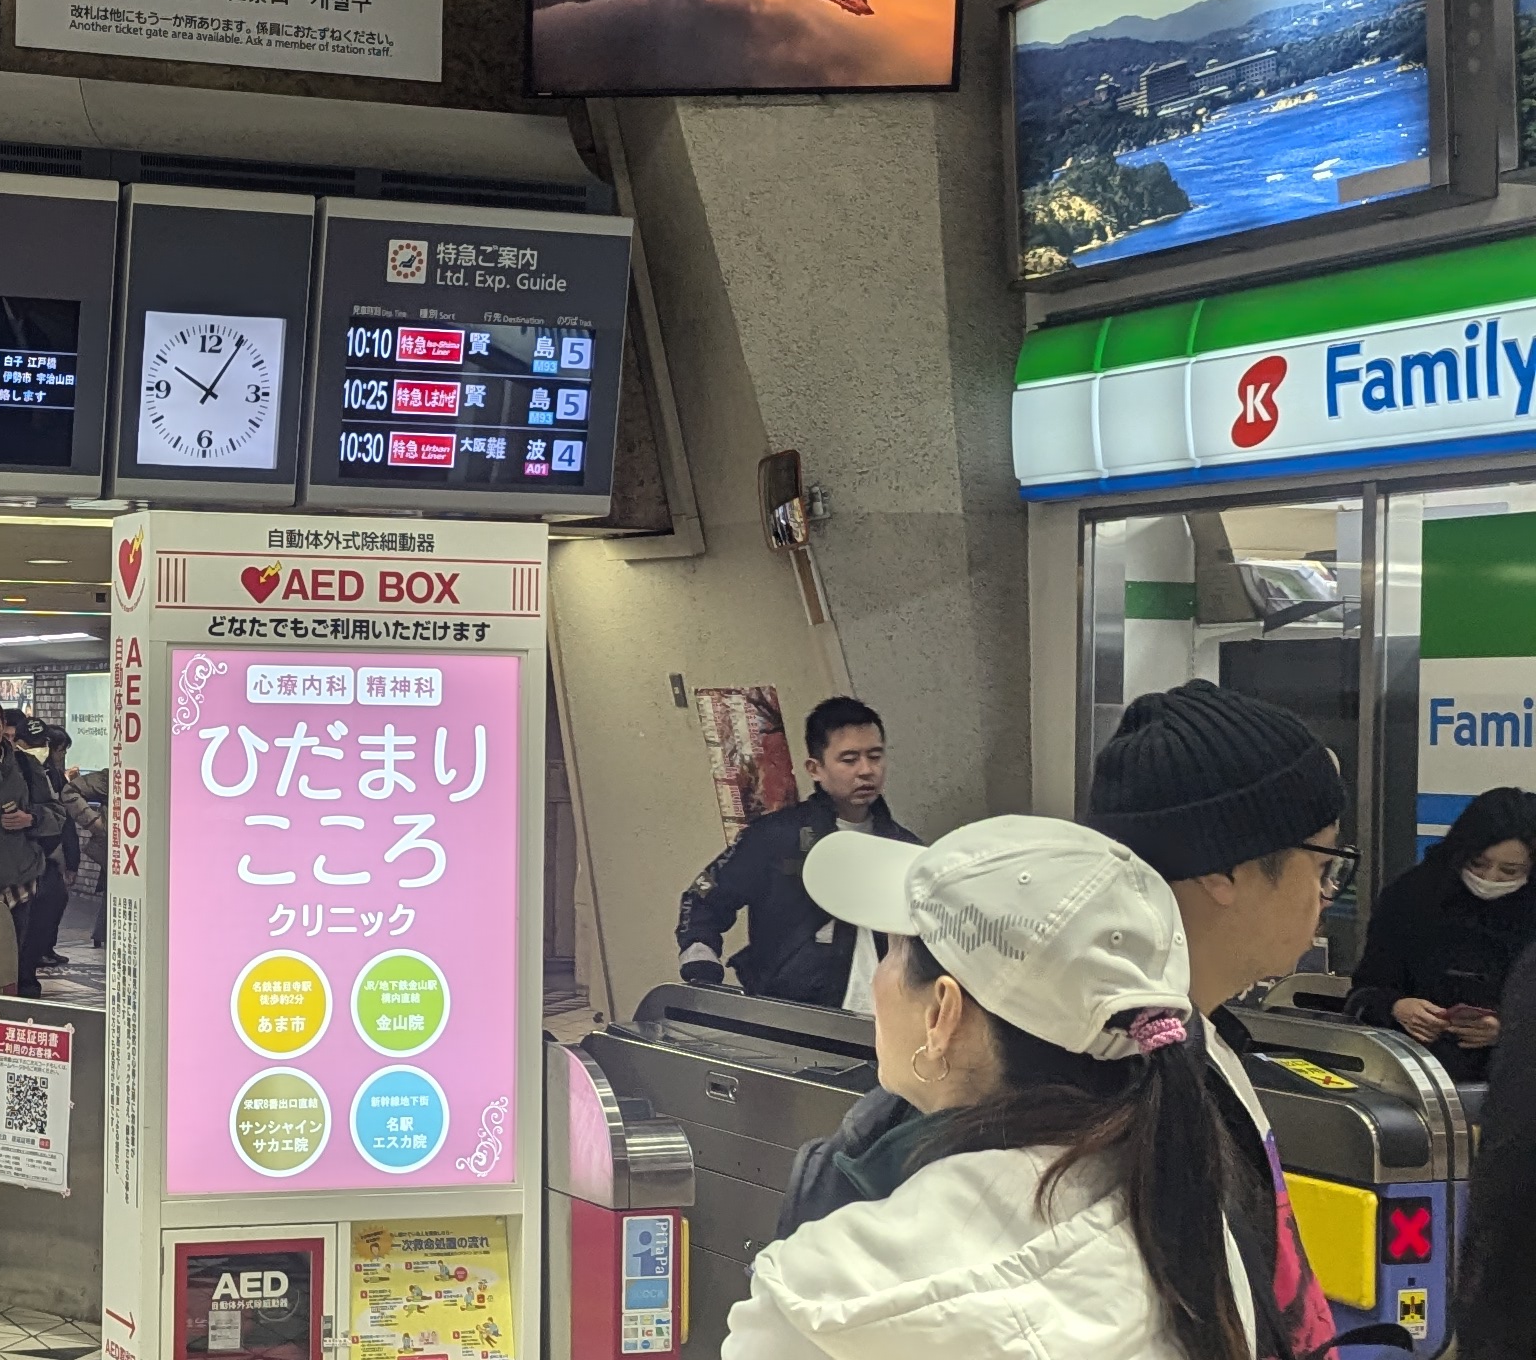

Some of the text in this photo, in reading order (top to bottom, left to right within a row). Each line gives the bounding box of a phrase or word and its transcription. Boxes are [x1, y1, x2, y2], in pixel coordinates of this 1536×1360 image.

[69, 20, 112, 34] Another
[115, 23, 143, 36] ticket
[146, 27, 168, 40] gate
[172, 30, 193, 41] area
[197, 32, 242, 44] available.
[246, 35, 263, 47] Ask
[275, 39, 316, 51] member
[319, 40, 328, 51] of
[332, 42, 364, 54] station
[368, 45, 392, 57] staff.
[436, 243, 538, 270] 特急ご案内
[436, 272, 567, 293] Ltd. Exp. Guide
[201, 334, 223, 353] 12
[347, 327, 392, 359] 10:10
[400, 336, 426, 354] 特急
[469, 332, 555, 359] 賢島
[568, 342, 584, 365] 5
[4, 355, 23, 367] 白子
[535, 361, 556, 372] M93
[1246, 318, 1536, 424] K Family
[3, 371, 31, 383] 伊勢市
[36, 372, 74, 385] 宇治山田
[155, 380, 261, 403] 9 3
[344, 379, 580, 416] 10:25 特急 しまかぜ 賢島 5
[531, 412, 552, 424] M93
[197, 429, 213, 448] 6
[340, 432, 575, 467] 10:30 特急 Urban 大阪難波 4
[421, 452, 446, 460] Liner
[526, 464, 546, 474] A01
[267, 529, 435, 553] 自動体外式除細動器
[281, 568, 460, 605] AED BOX
[207, 615, 491, 642] どなたでもご利用いただけます
[125, 637, 142, 743] AED
[253, 674, 435, 699] 心療内科 精神科
[1430, 697, 1534, 747] Fami
[199, 720, 487, 802] ひだまり
[123, 769, 141, 876] BOX
[237, 813, 447, 888] こころ
[268, 903, 416, 937] クリニック
[364, 980, 437, 991] JR/地下鉄金山駅
[259, 994, 304, 1005] 徒歩約2分
[257, 1016, 306, 1033] あま市
[376, 1014, 425, 1031] 金山院
[5, 1027, 59, 1047] 遅延証明書
[371, 1096, 429, 1107] 新幹線地下街
[239, 1120, 322, 1135] サンシャイン
[386, 1116, 413, 1132] 名駅
[253, 1138, 308, 1153] サカエ院
[373, 1134, 427, 1149] エスカ院
[655, 1221, 669, 1275] PiTaPa
[212, 1271, 289, 1299] AED
